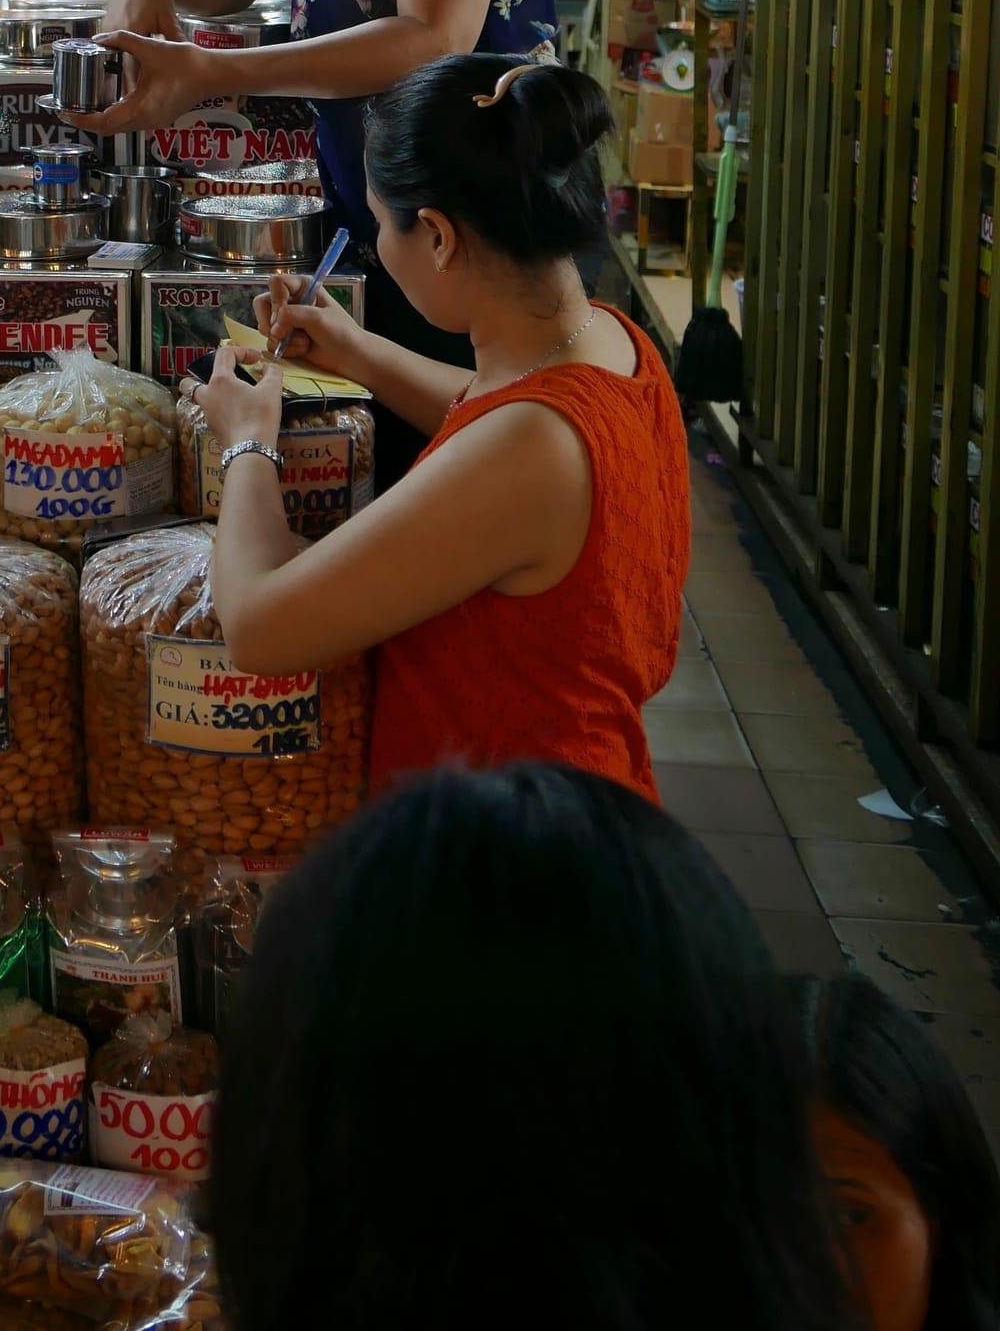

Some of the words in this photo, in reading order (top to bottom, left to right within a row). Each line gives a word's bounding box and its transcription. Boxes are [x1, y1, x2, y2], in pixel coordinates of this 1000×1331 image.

[155, 119, 235, 166] VIỆT
[244, 129, 316, 161] NAM
[159, 288, 221, 308] KOPI
[301, 442, 333, 460] GIÁ
[36, 496, 114, 519] 100G
[156, 674, 175, 688] Tên
[156, 700, 208, 727] GIÁ:
[91, 970, 138, 983] THANH
